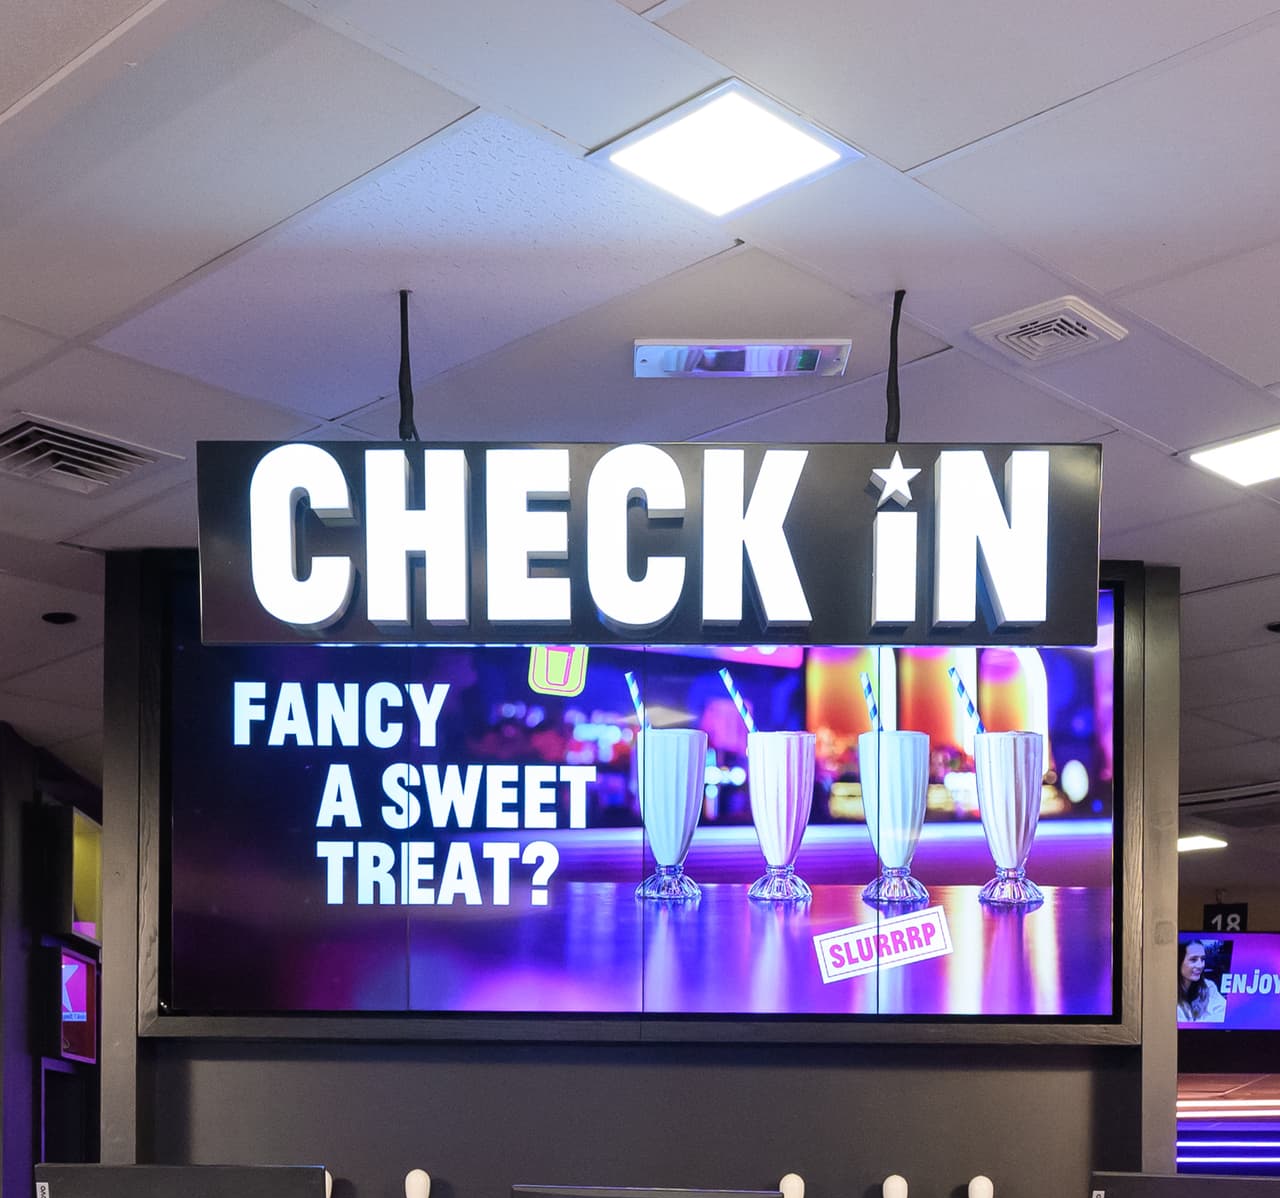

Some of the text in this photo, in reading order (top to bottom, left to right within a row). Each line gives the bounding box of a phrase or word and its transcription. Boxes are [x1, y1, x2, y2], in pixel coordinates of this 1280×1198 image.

[249, 443, 813, 629] CHECK
[233, 682, 450, 747] FANCY
[316, 764, 597, 830] A SWEET
[317, 841, 560, 906] TREAT?
[829, 922, 936, 969] SLURRRP
